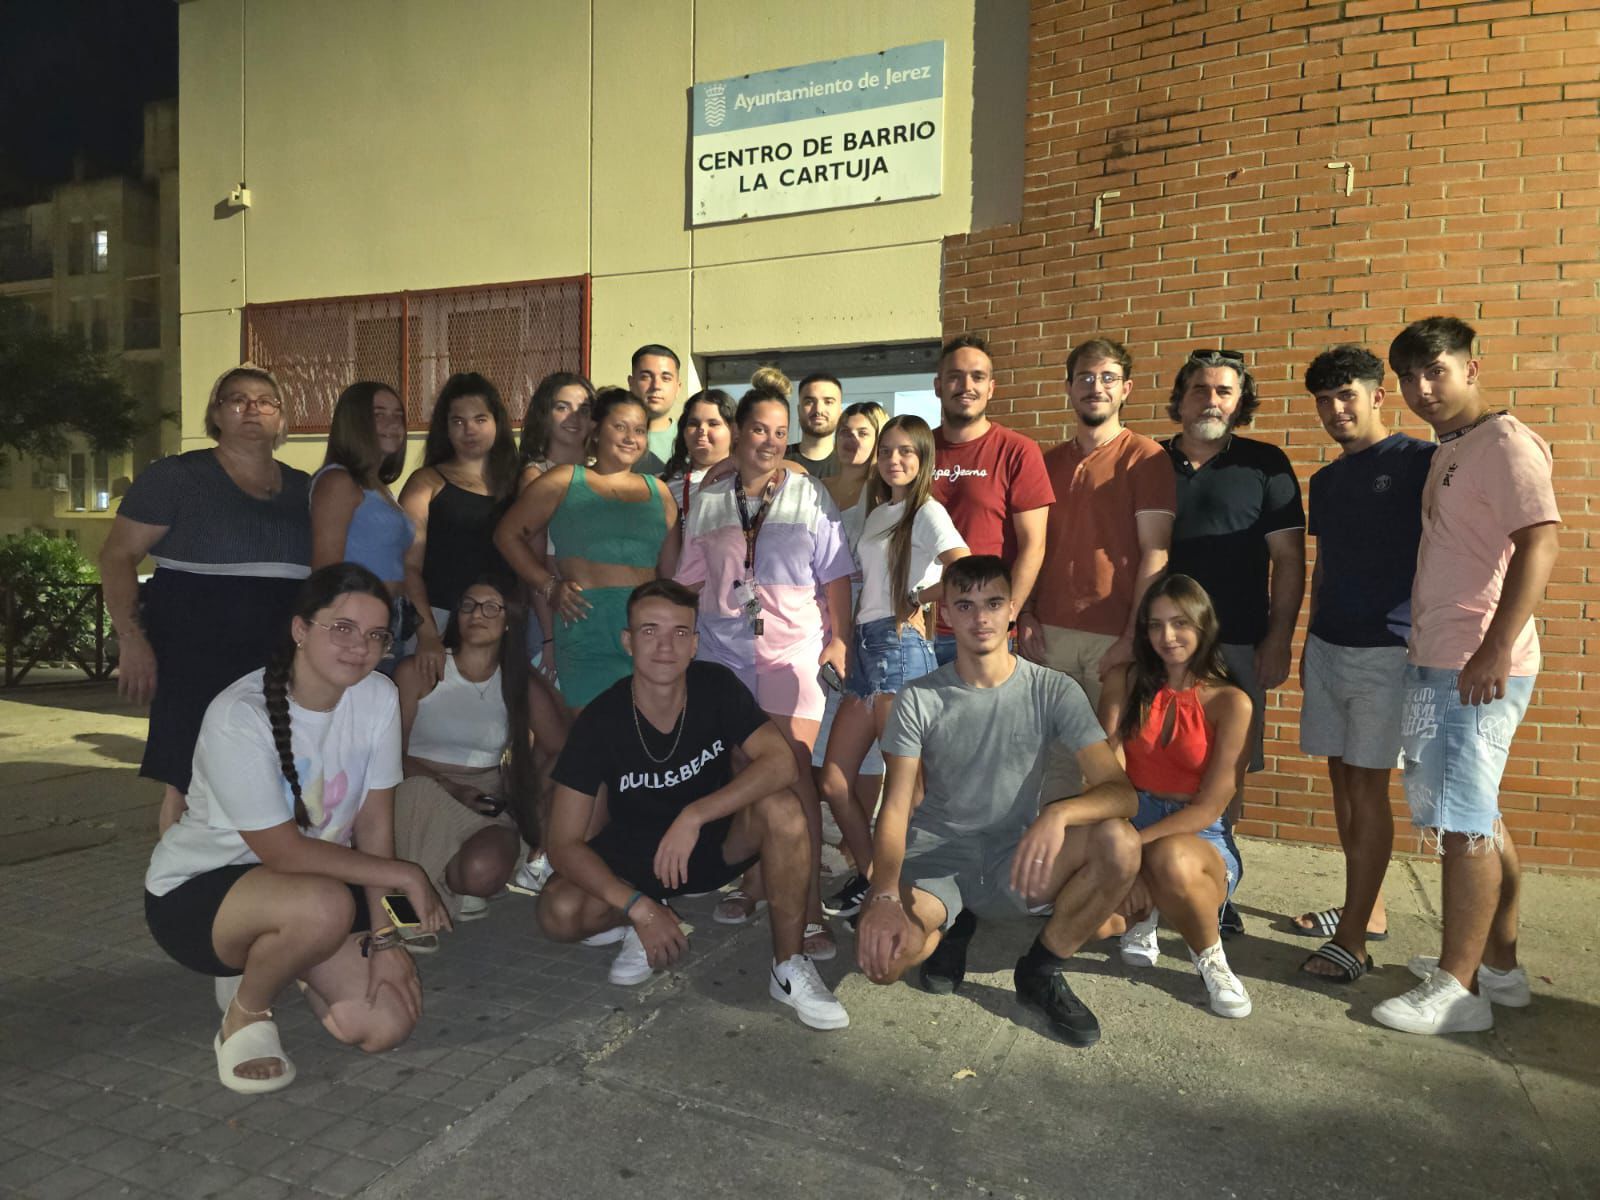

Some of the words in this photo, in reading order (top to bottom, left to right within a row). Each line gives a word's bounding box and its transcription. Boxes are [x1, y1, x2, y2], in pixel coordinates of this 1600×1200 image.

[733, 80, 853, 112] Ayuntamiento
[858, 71, 880, 89] de
[884, 65, 932, 90] Jerez
[698, 142, 793, 172] CENTRO
[803, 135, 833, 157] DE
[843, 120, 936, 152] BARRIO
[739, 173, 769, 193] LA
[779, 156, 889, 187] CARTUJA
[949, 464, 988, 482] Jeans
[619, 738, 726, 793] PULL&BEAR
